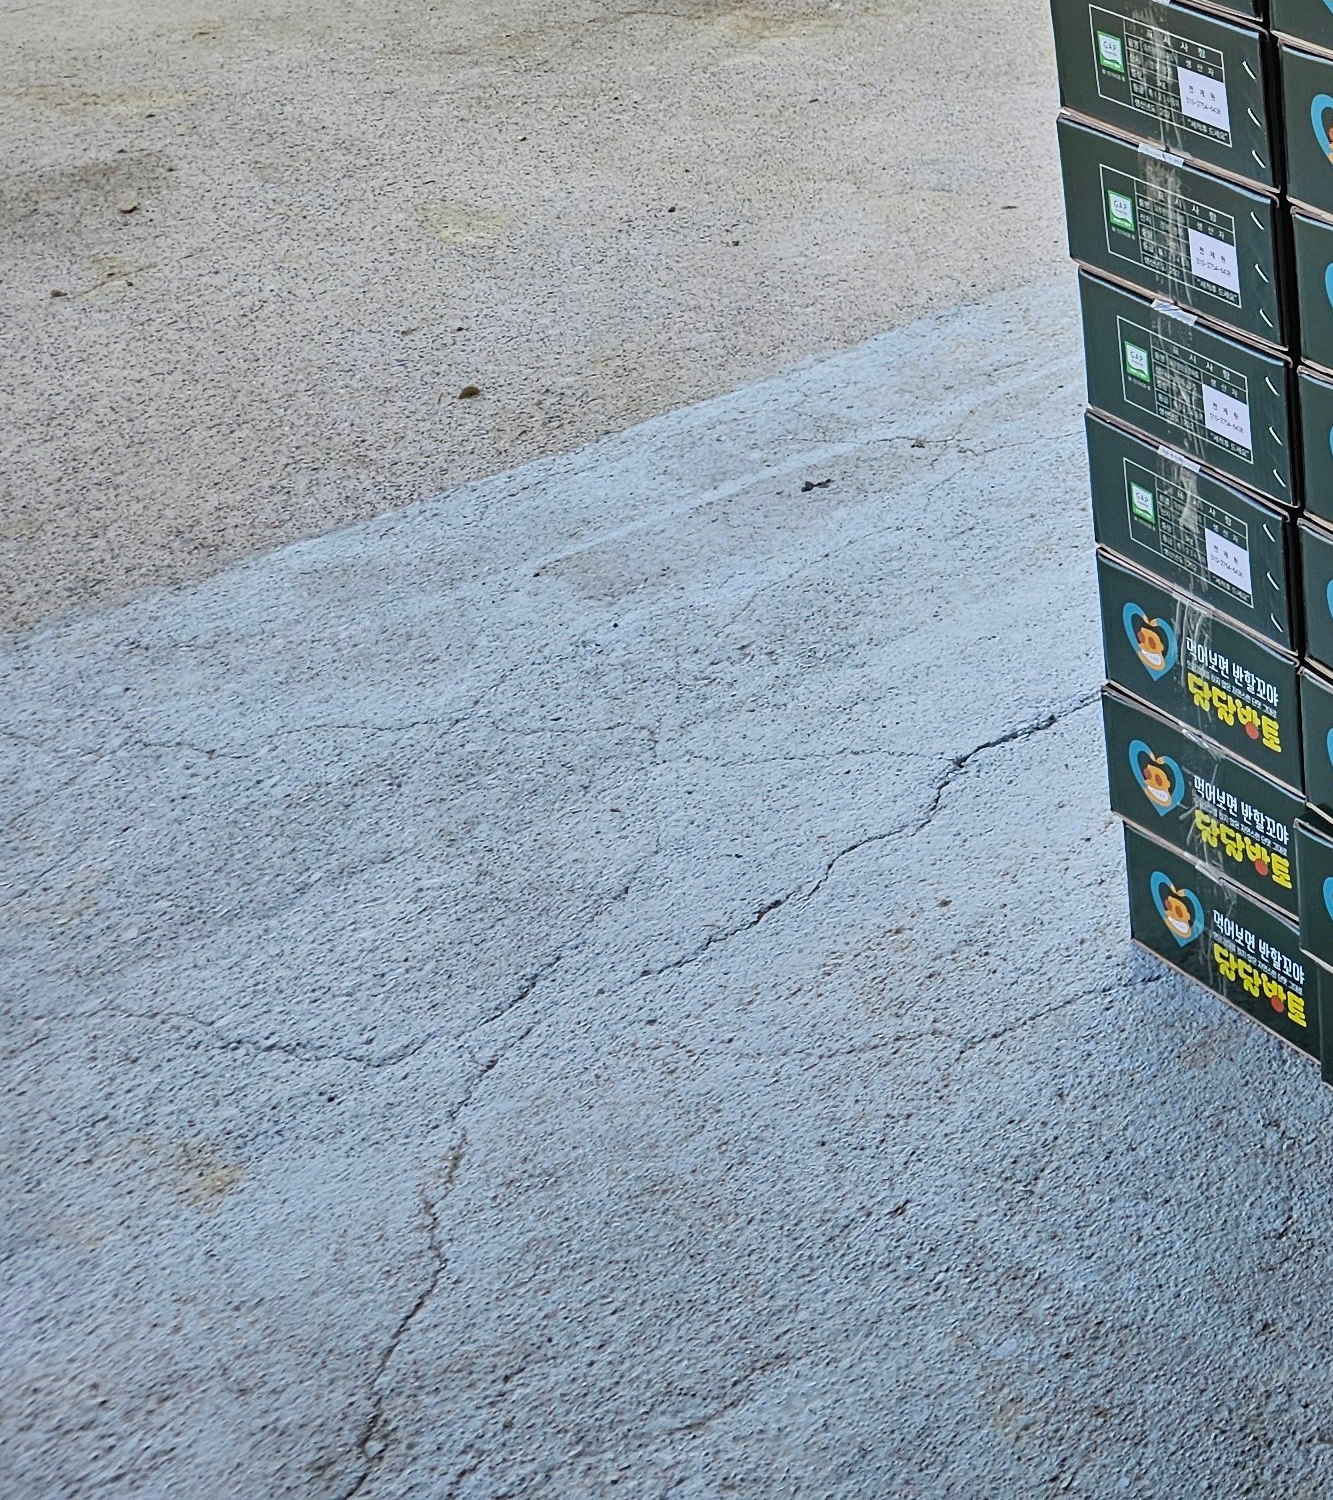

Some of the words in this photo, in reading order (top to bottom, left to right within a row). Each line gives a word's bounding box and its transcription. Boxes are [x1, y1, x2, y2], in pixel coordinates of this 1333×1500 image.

[1186, 637, 1229, 680] 먹어보면
[1232, 665, 1279, 706] 반할꼬야
[1194, 774, 1238, 813] 먹어보면
[1241, 800, 1289, 844] 반할꼬야
[1213, 909, 1256, 952] 먹어보면
[1259, 940, 1305, 985] 반할꼬야
